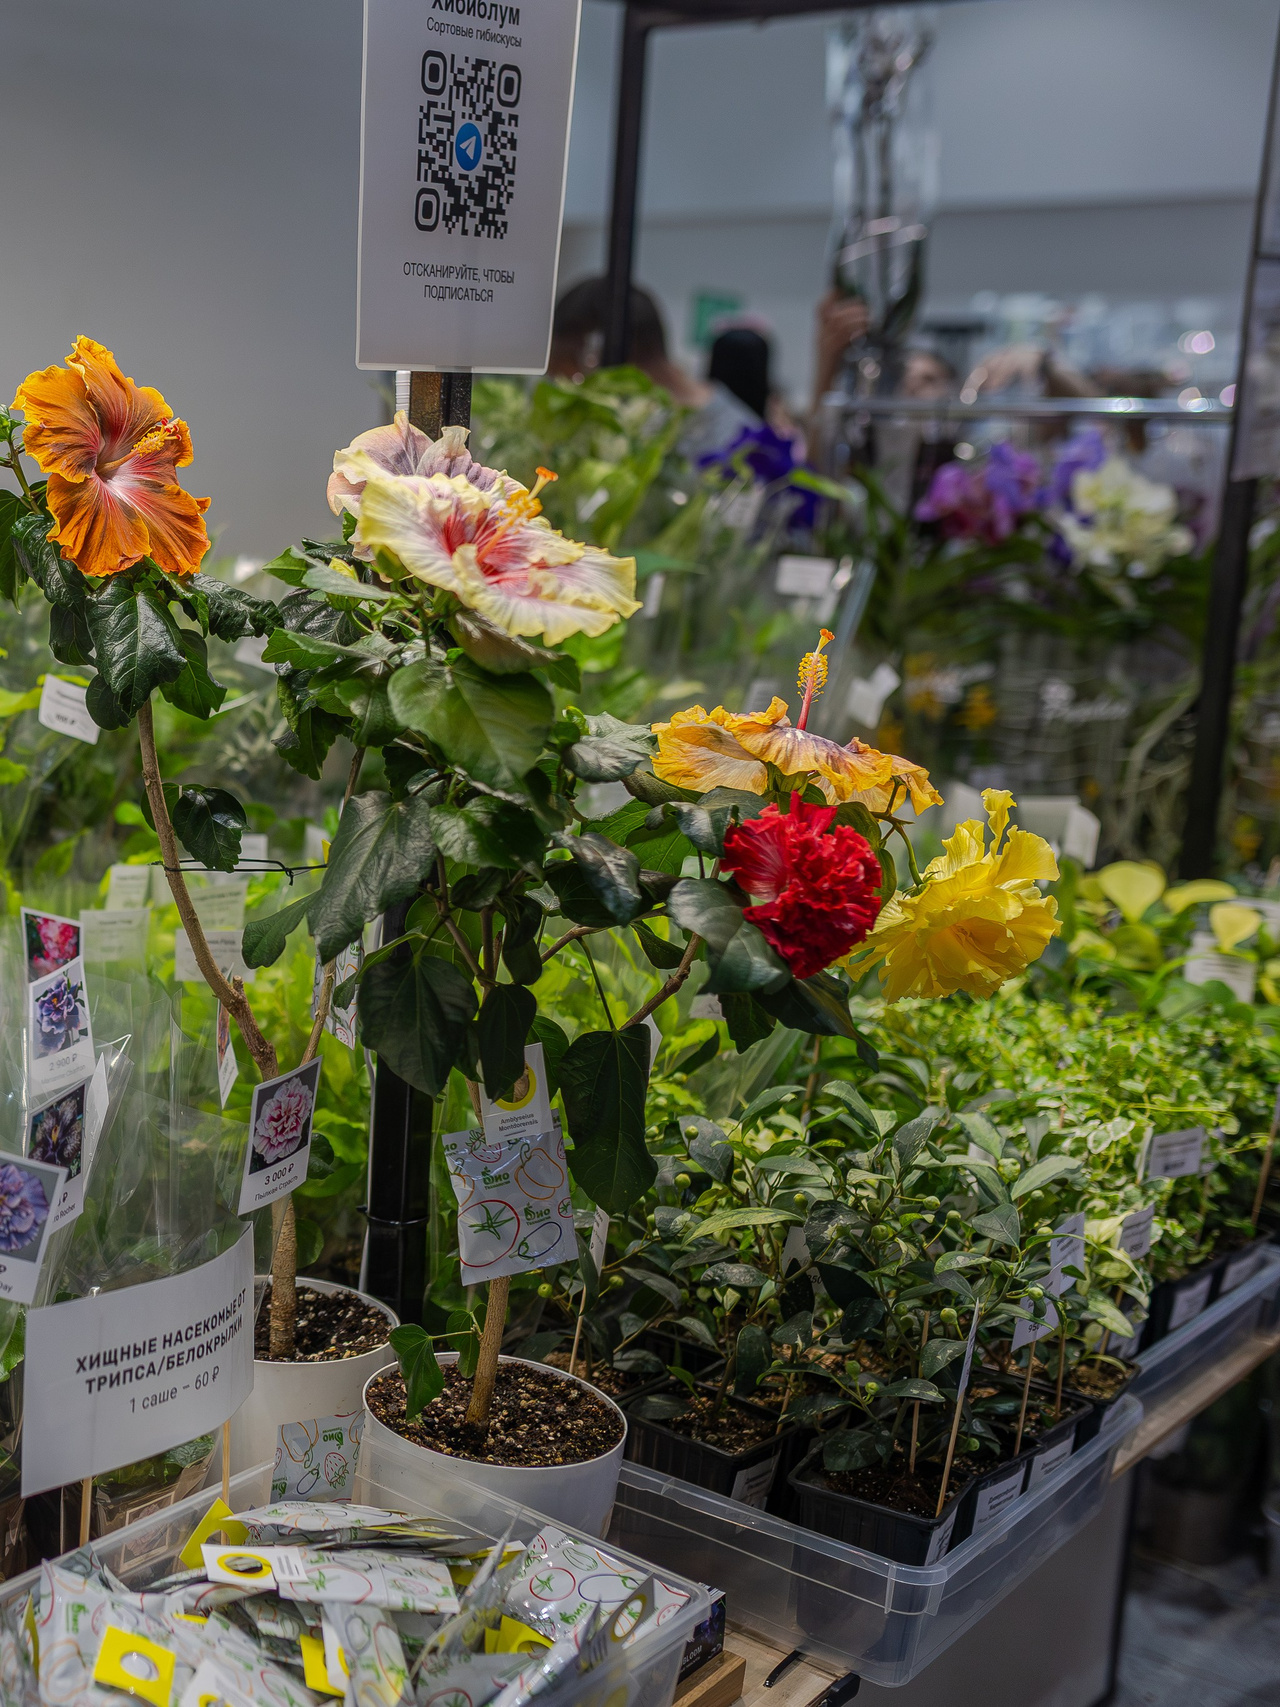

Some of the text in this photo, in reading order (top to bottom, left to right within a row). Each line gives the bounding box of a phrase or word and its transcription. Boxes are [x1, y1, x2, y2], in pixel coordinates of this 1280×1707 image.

[431, 0, 520, 28] Хибиблум
[426, 16, 522, 48] Сортовые гибискусы
[403, 262, 515, 284] ОТСКАНИРУЙТЕ, ЧТОБЫ
[423, 284, 494, 303] ПОДПИСАТЬСЯ
[498, 1119, 539, 1132] Montdorensis
[500, 1112, 535, 1125] Amblyseius
[255, 1175, 298, 1201] Пылкая Страсть
[264, 1175, 270, 1185] 3
[272, 1167, 287, 1182] 000
[76, 1288, 247, 1374] ХИЩНЫЕ НАСЕКОМЫЕ ОТ
[86, 1314, 243, 1394] ТРИПСА/БЕЛОКРЫЛКИ
[130, 1397, 136, 1414] 1
[141, 1386, 178, 1410] саше
[194, 1371, 209, 1391] 60
